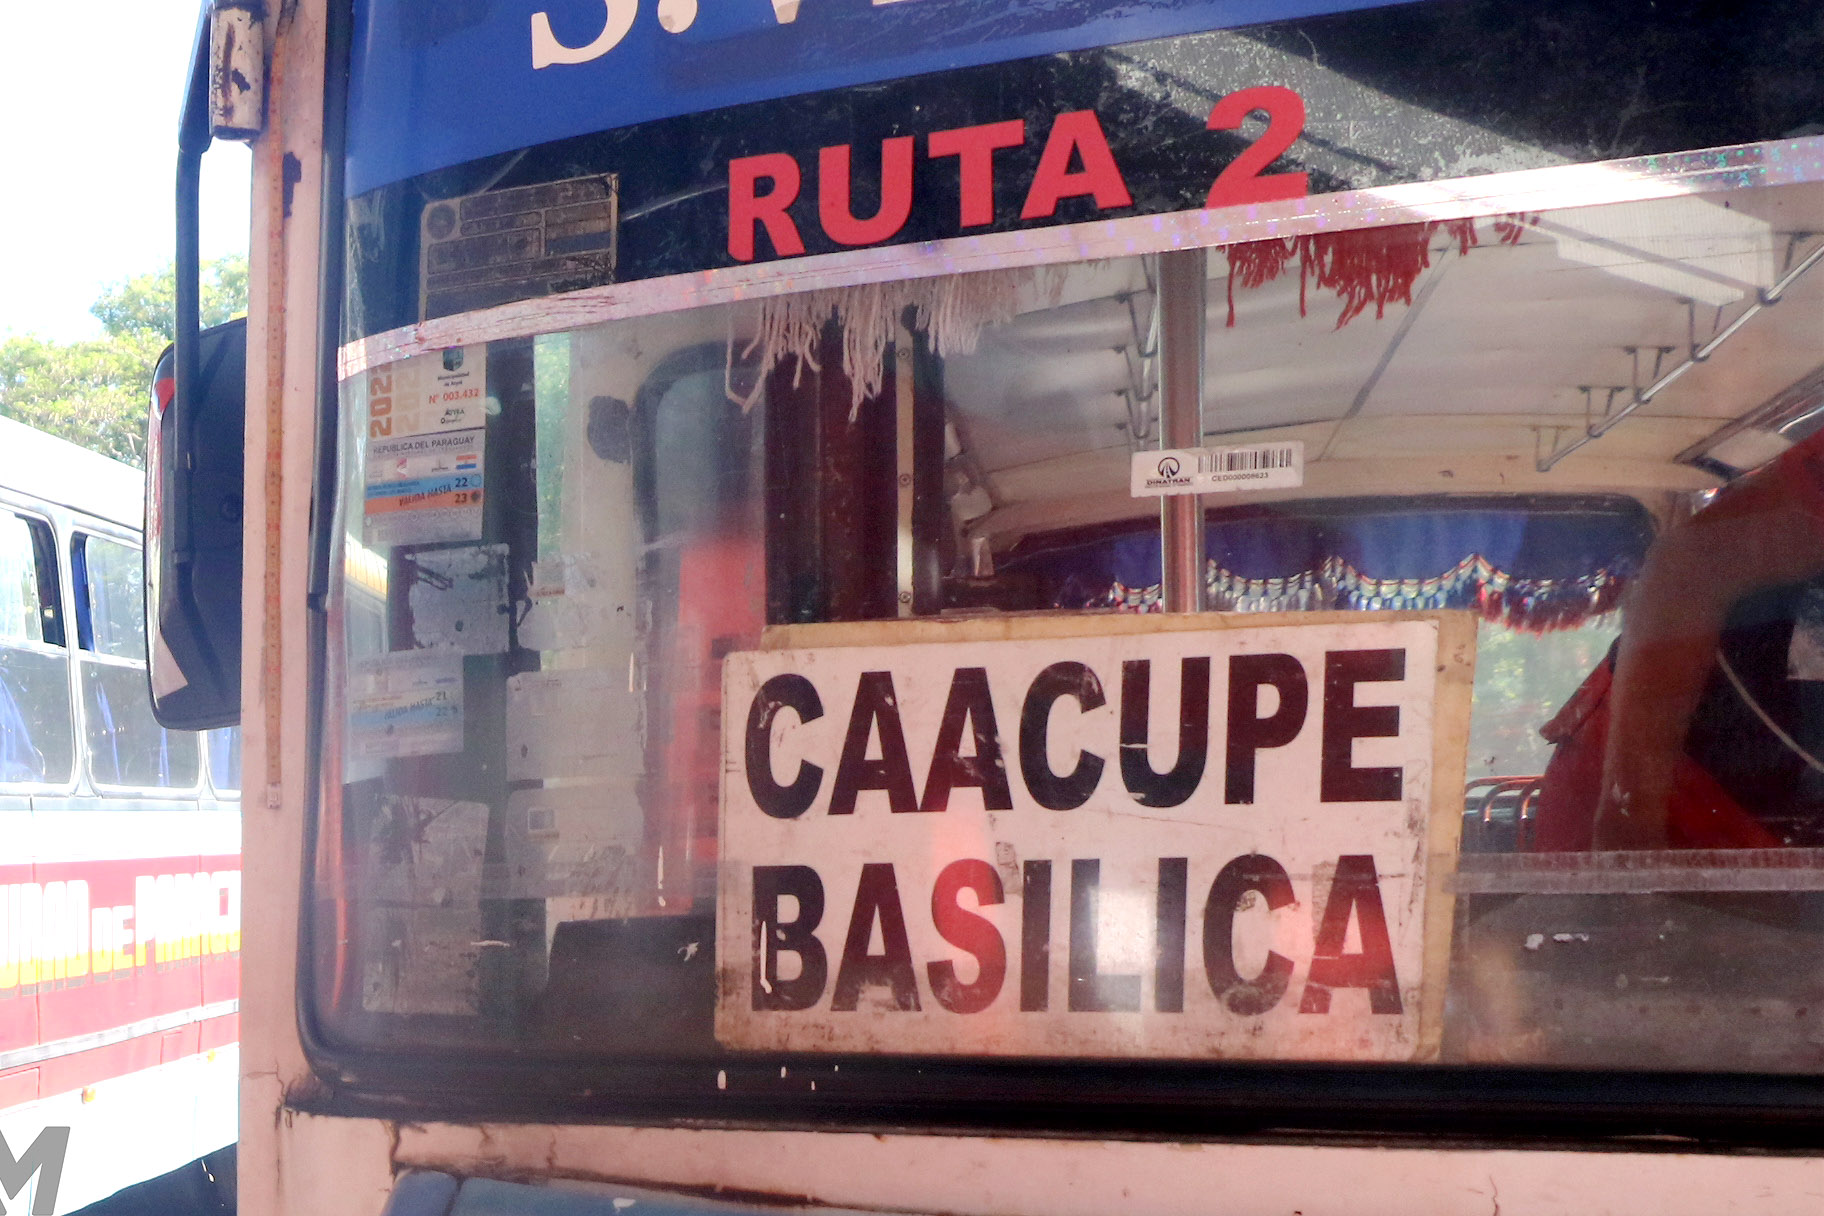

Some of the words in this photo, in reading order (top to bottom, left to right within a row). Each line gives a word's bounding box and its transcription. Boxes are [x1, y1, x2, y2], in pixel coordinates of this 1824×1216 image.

[728, 108, 1132, 262] RUTA
[1205, 85, 1308, 210] 2
[431, 436, 475, 448] PARAGUAY
[744, 646, 1407, 819] CAACUPE
[92, 904, 134, 974] DE
[751, 854, 1404, 1015] BASILICA
